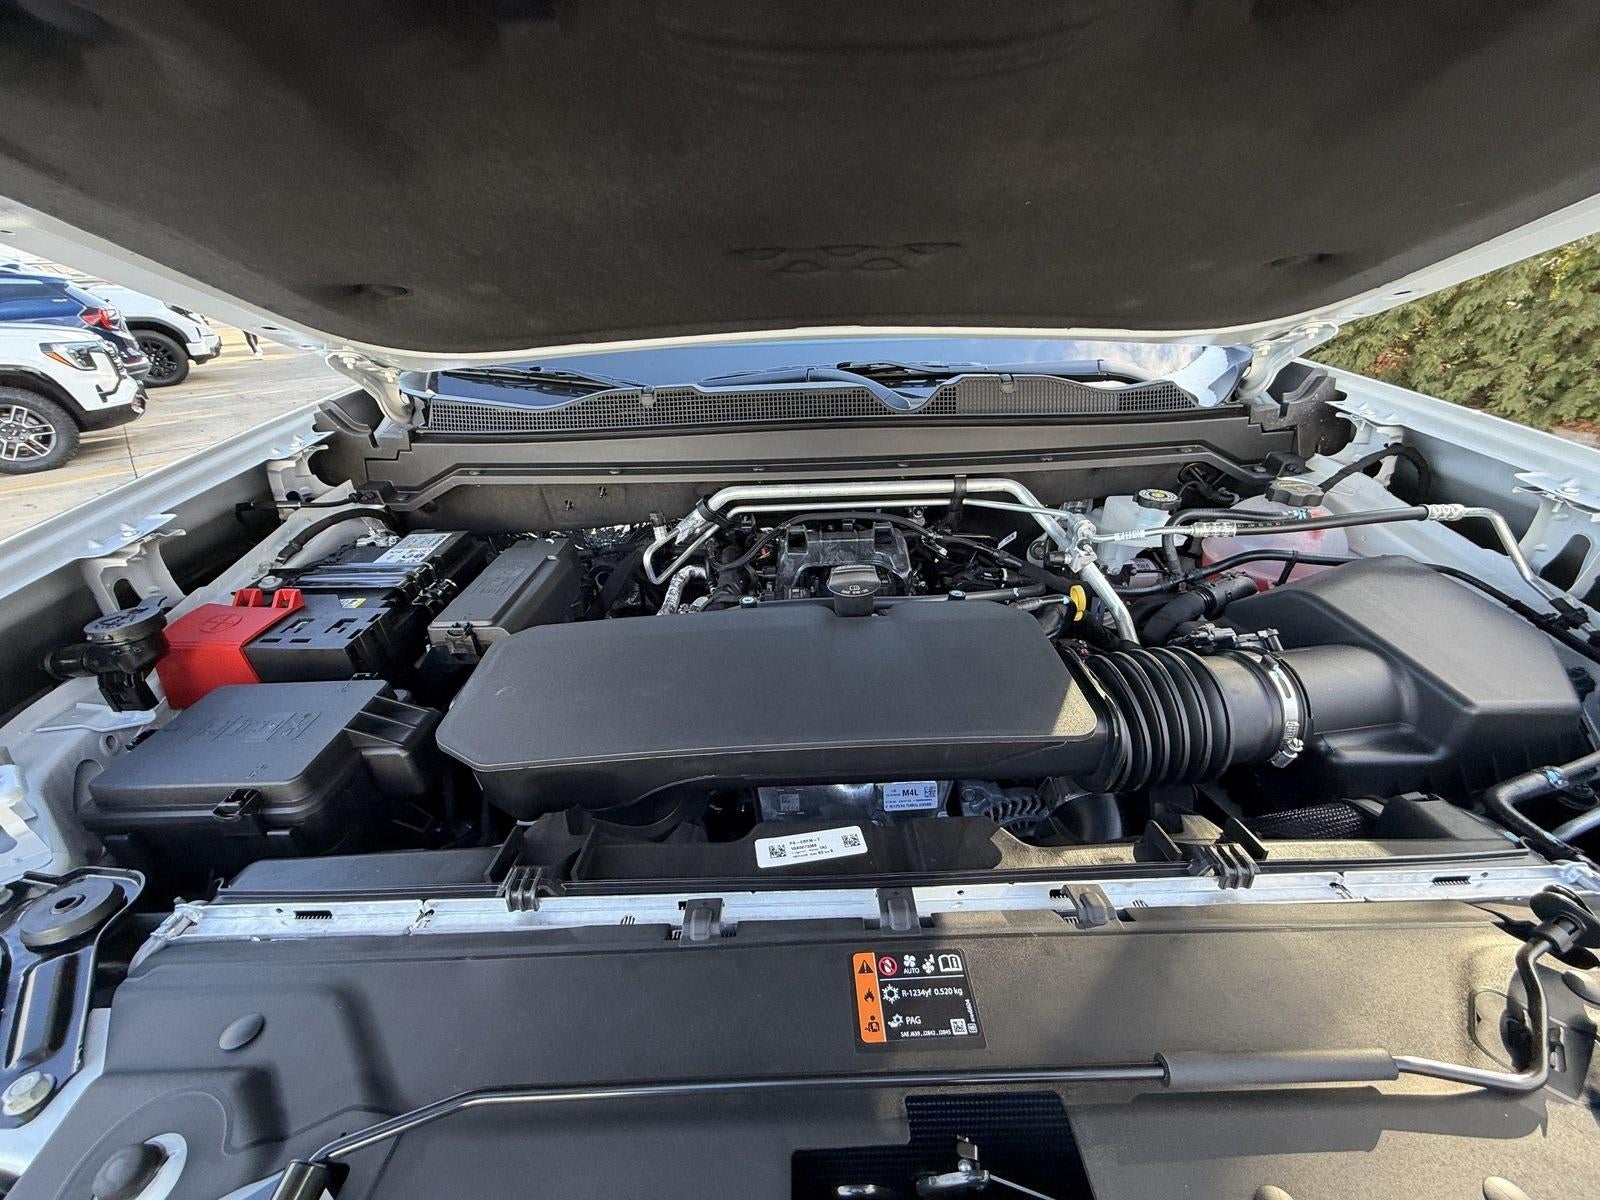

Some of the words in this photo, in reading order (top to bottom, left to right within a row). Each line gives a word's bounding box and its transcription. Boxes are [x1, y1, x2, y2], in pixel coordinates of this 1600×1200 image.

[902, 789, 919, 797] M4L
[903, 967, 920, 975] AUTO
[902, 988, 932, 997] R-1234yf
[934, 987, 953, 996] 0.520
[954, 987, 963, 996] kg
[905, 1015, 921, 1025] PAG
